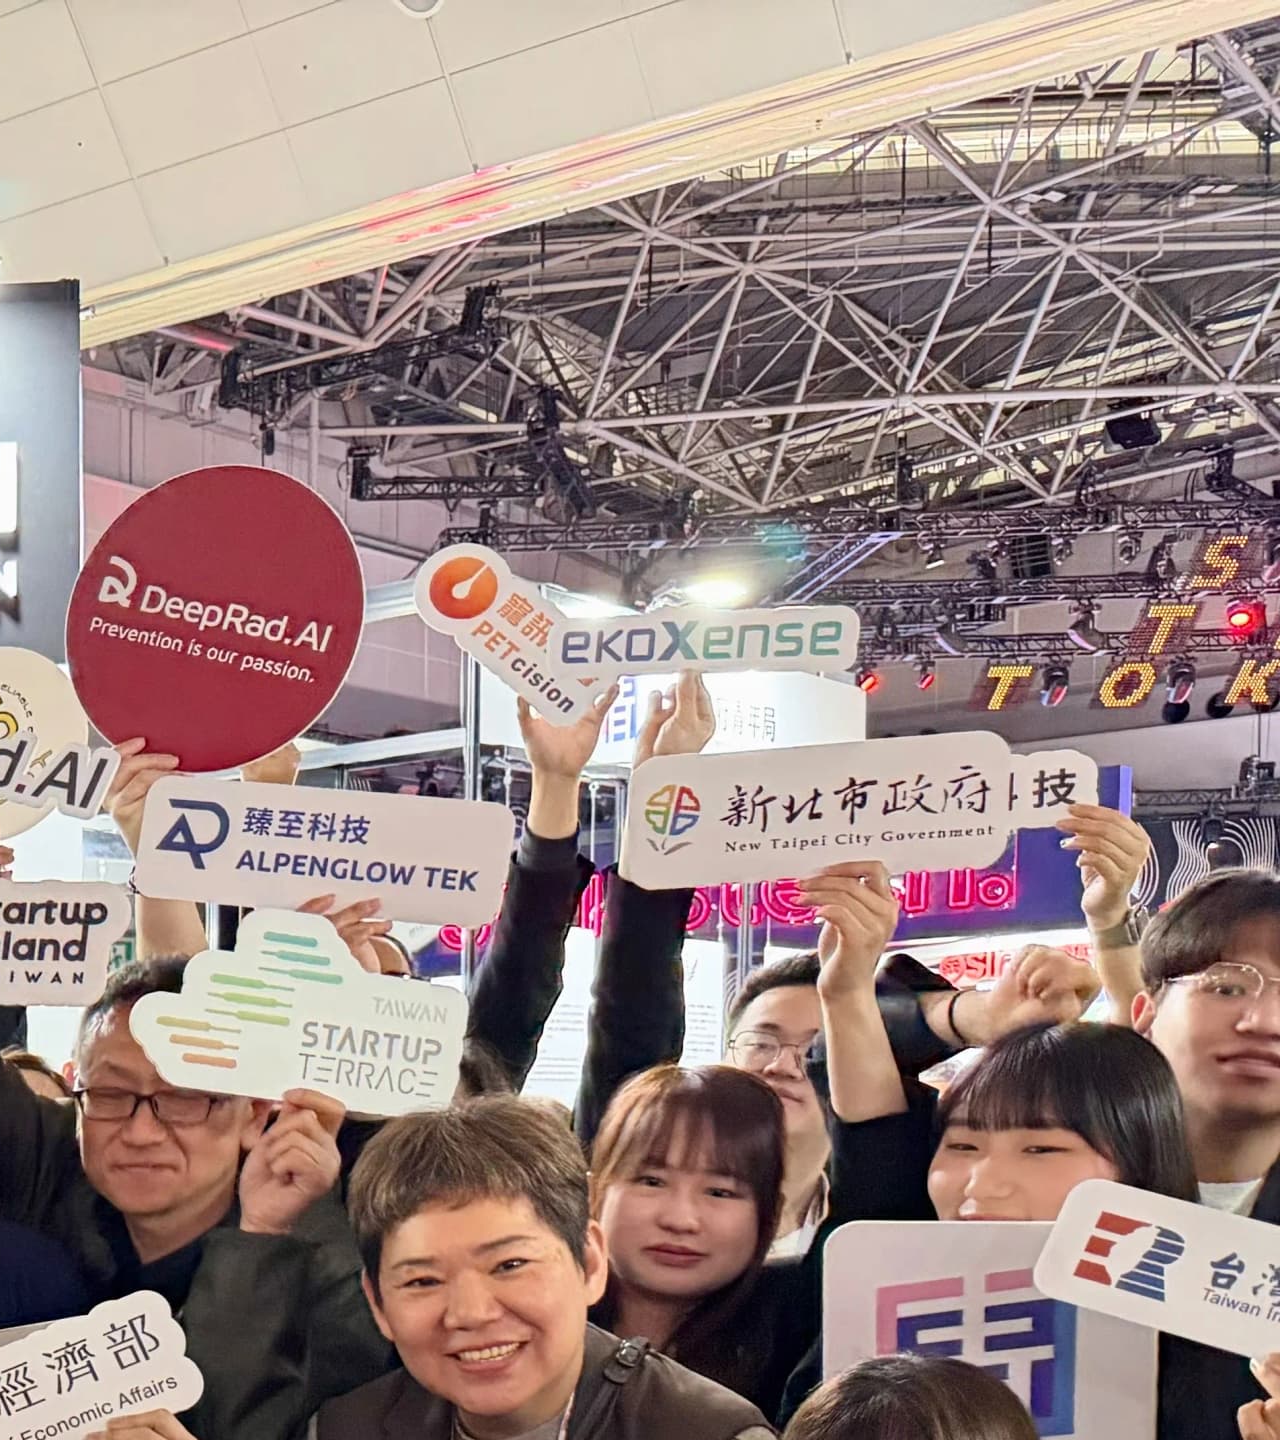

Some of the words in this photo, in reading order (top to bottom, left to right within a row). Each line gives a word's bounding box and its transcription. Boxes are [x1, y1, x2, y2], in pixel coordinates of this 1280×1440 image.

[140, 583, 333, 654] DeepRad.AI
[89, 616, 184, 656] Prevention
[186, 636, 203, 659] is
[206, 645, 238, 666] our
[240, 650, 316, 685] passion.
[560, 617, 843, 666] ekoXense
[470, 620, 575, 714] PETcision
[719, 765, 992, 833] 新北市政府
[241, 806, 372, 845] 臻至科技
[725, 839, 762, 853] New
[770, 834, 827, 851] Taipei
[835, 831, 872, 848] City
[881, 824, 997, 843] Government
[236, 849, 416, 886] ALPENGLOW
[423, 865, 479, 893] TEK
[372, 996, 447, 1024] TAIWAN
[301, 1020, 443, 1063] STARTUP
[298, 1051, 439, 1098] TERRACE
[1202, 1287, 1262, 1317] Taiwan
[118, 1372, 178, 1408] Affairs
